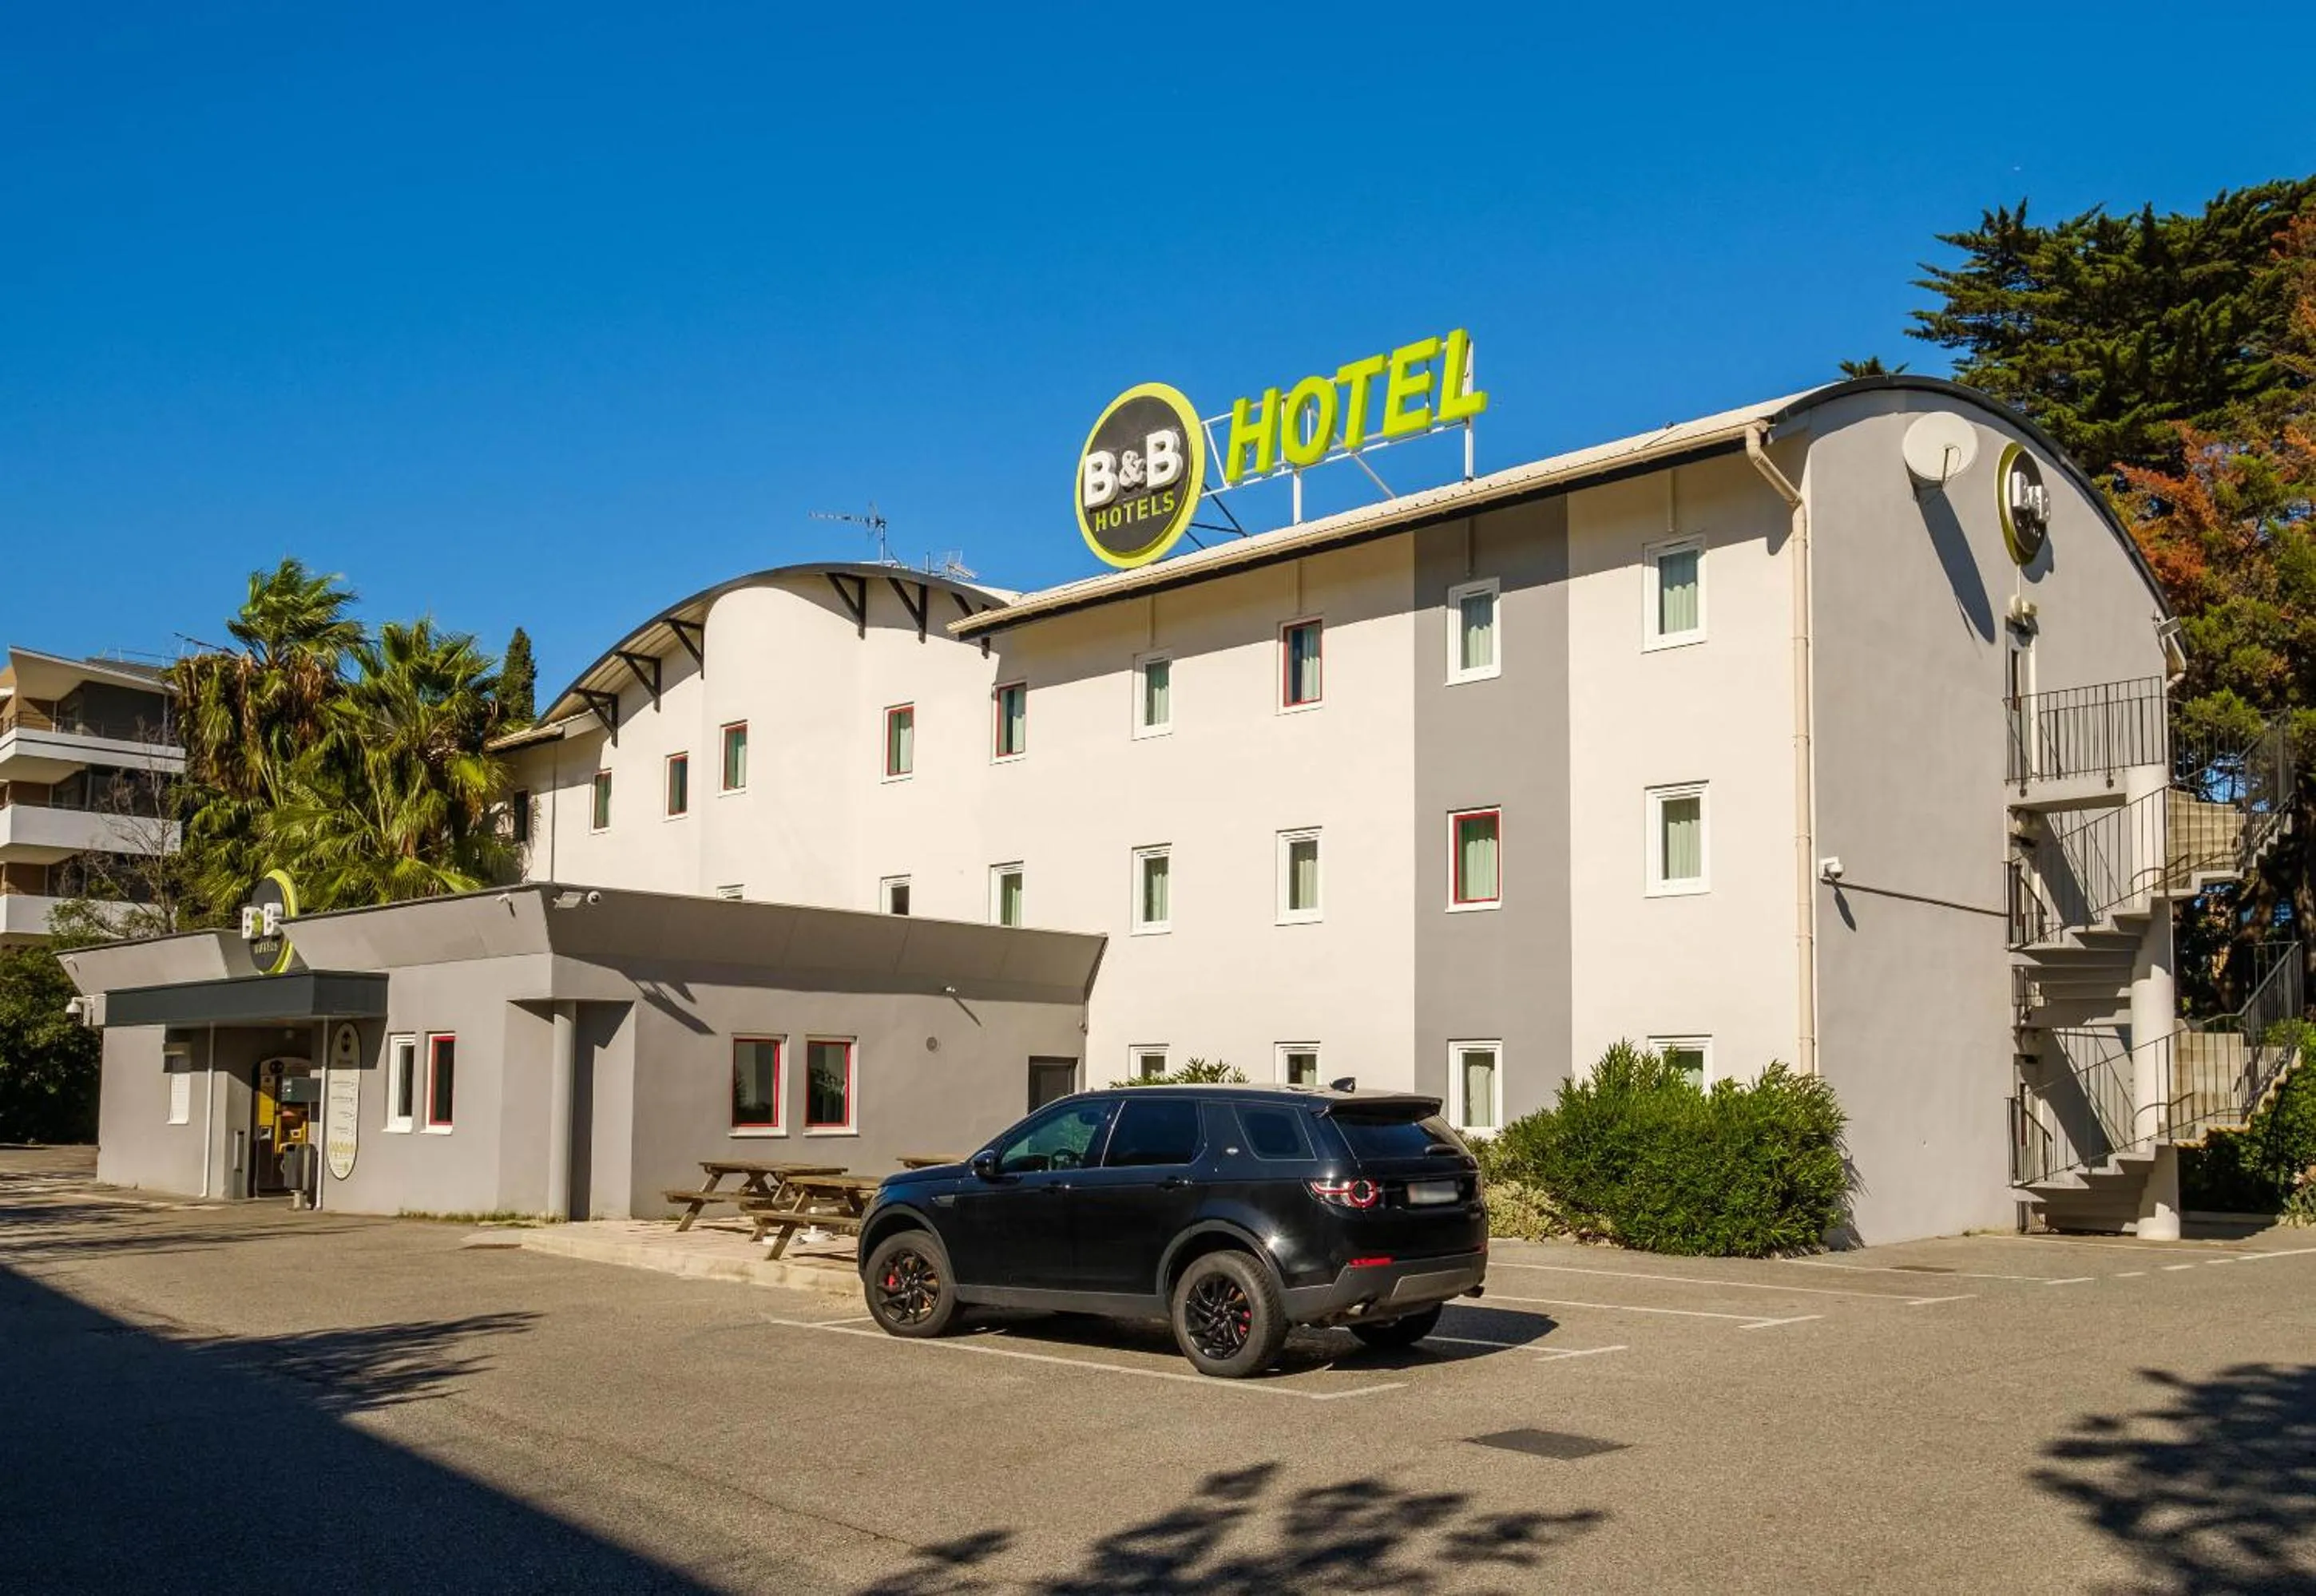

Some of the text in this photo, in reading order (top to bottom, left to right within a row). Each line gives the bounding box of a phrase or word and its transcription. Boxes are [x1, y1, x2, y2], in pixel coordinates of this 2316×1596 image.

[1225, 328, 1488, 482] HOTEL
[1084, 430, 1184, 508] B&B
[1095, 490, 1176, 533] HOTELS
